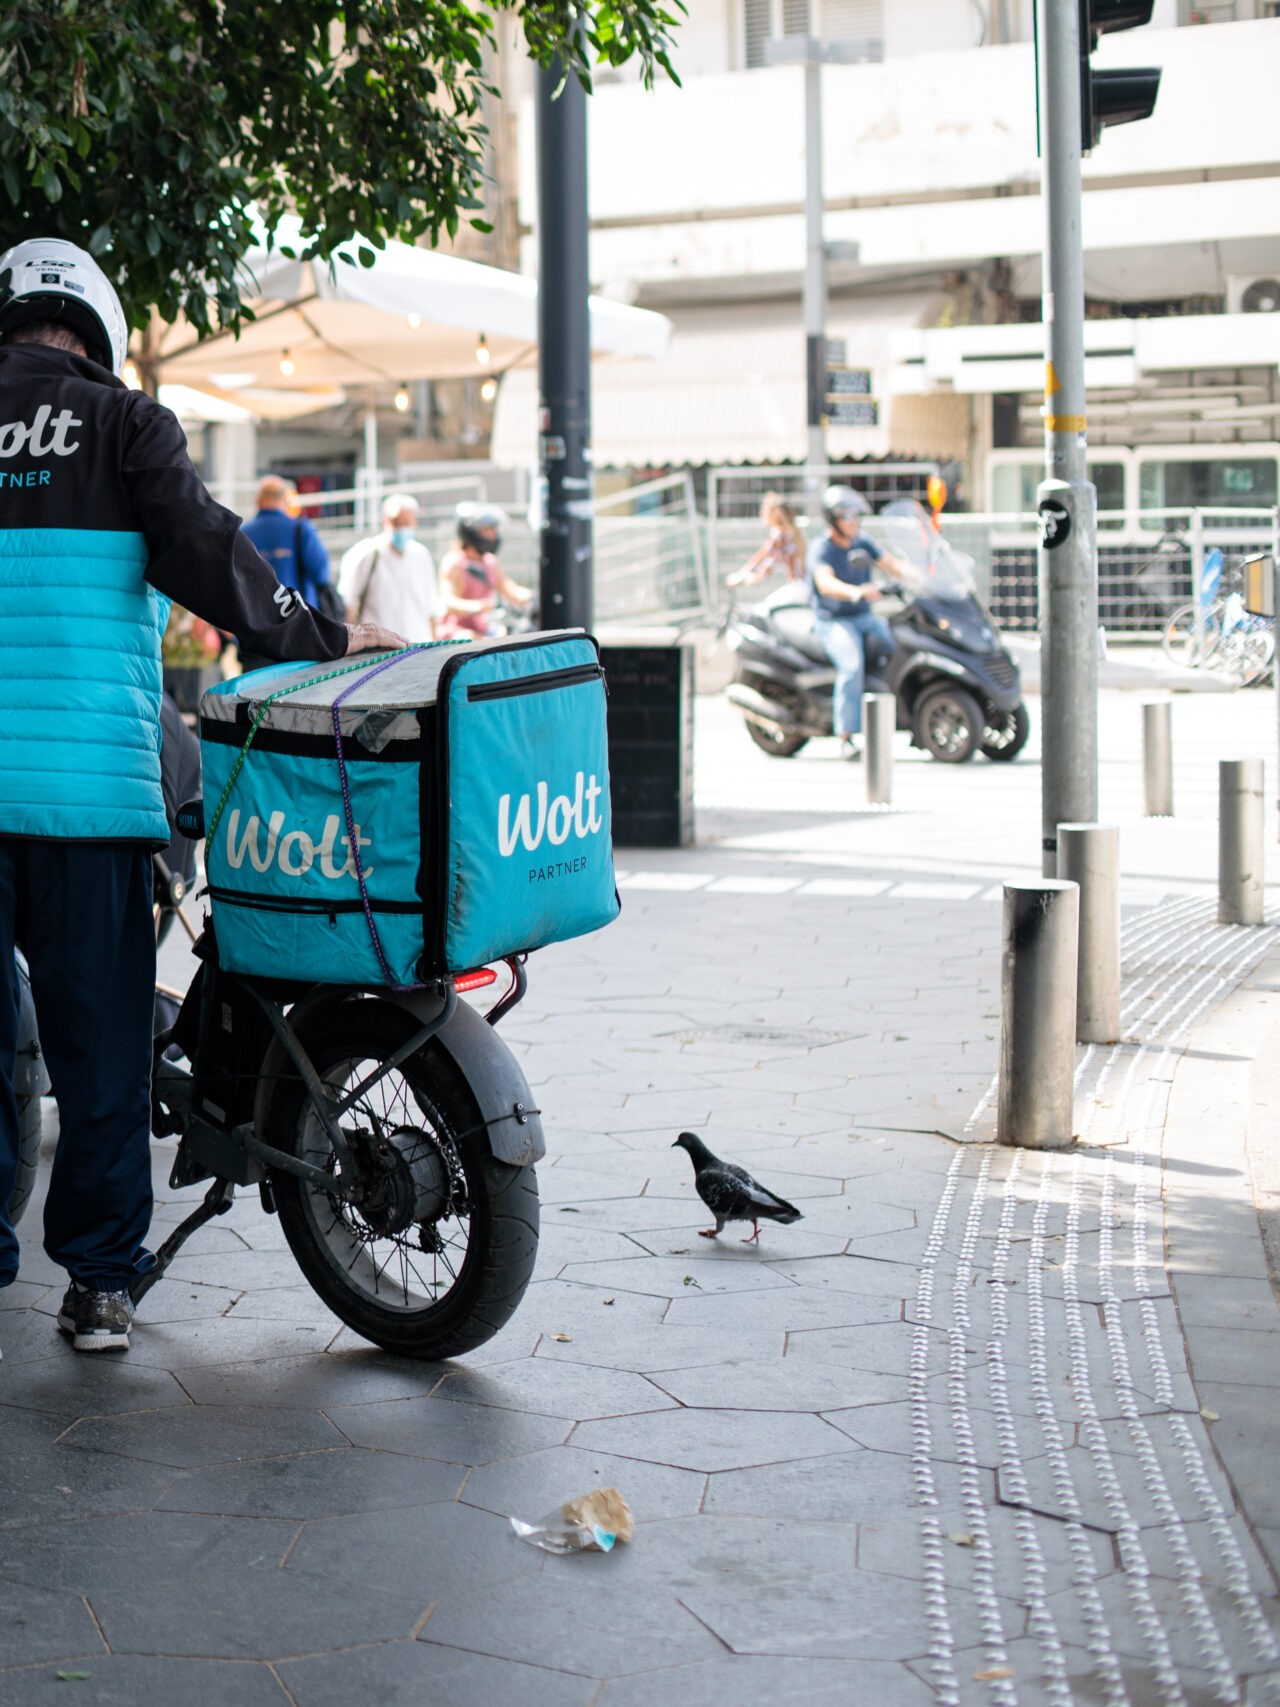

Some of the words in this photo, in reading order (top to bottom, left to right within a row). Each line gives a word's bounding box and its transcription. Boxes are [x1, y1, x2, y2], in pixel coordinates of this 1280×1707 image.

[226, 808, 374, 880] Wolt
[498, 771, 602, 857] Wolt
[529, 856, 587, 884] PARTNER
